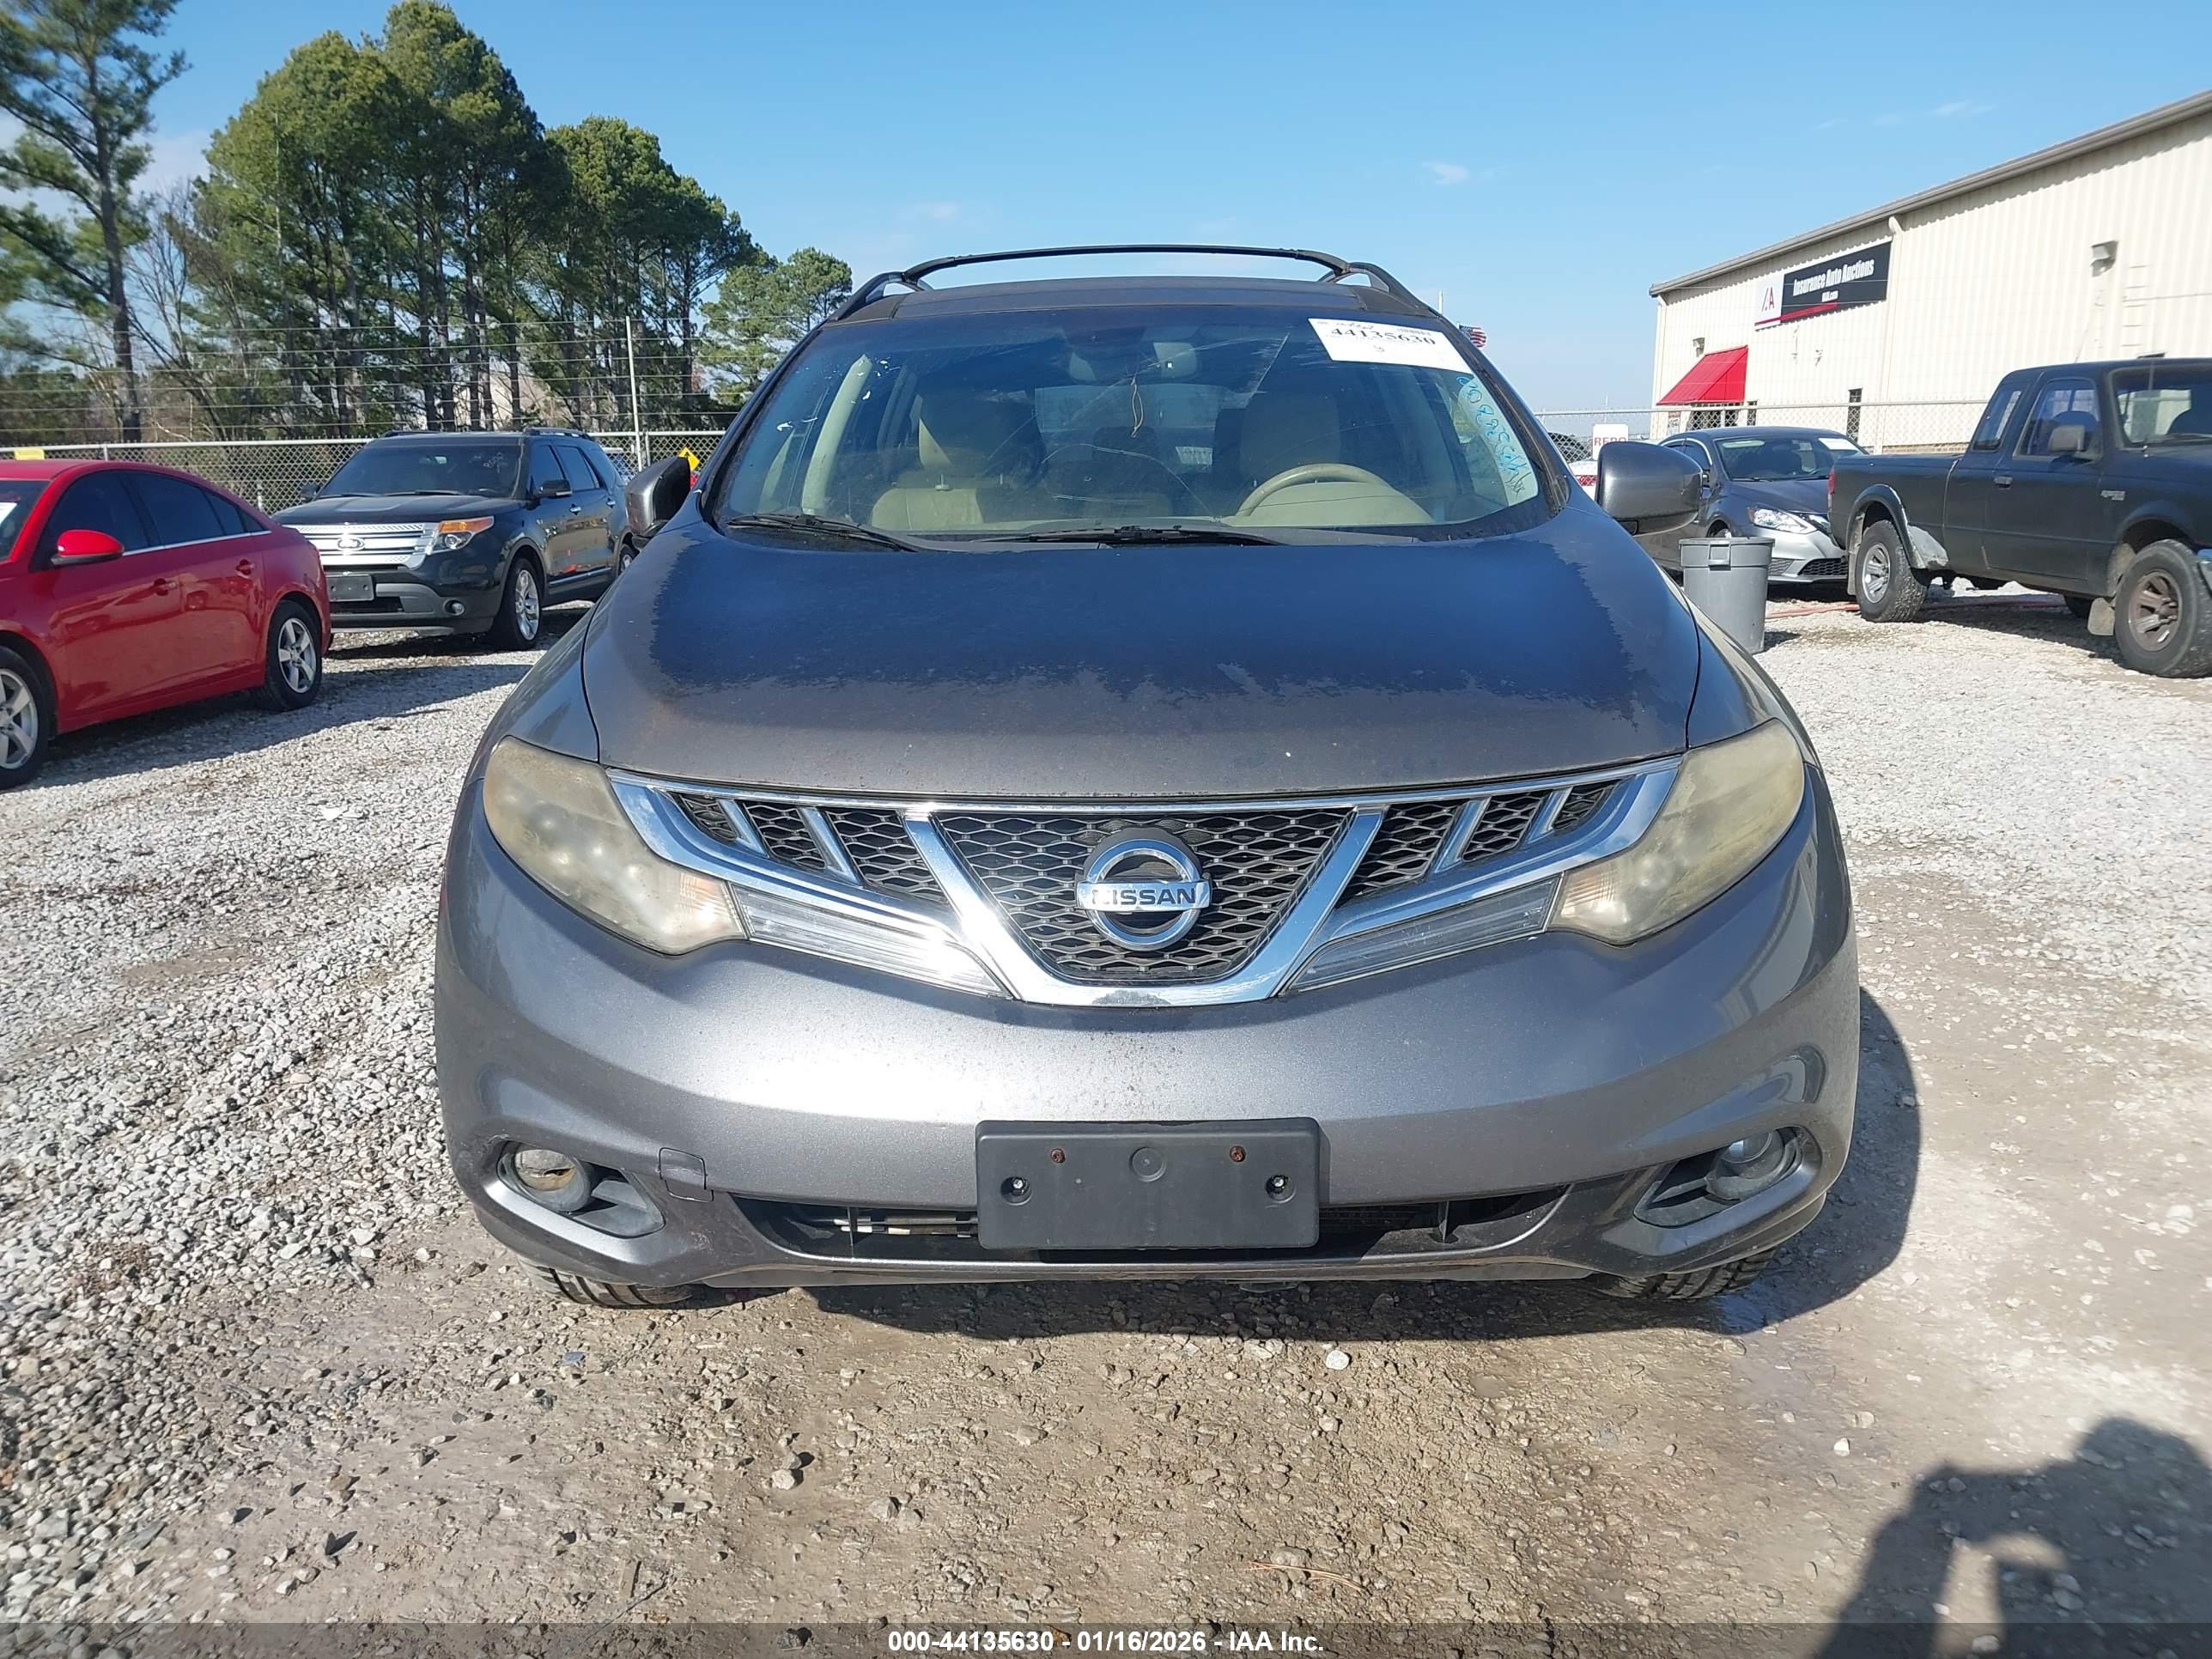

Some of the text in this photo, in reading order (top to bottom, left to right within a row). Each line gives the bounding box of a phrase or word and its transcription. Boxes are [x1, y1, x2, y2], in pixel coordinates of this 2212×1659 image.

[1793, 259, 1875, 296] Insurance Auto Auctions
[1331, 327, 1436, 345] 44135630
[1091, 887, 1196, 906] NISSAN
